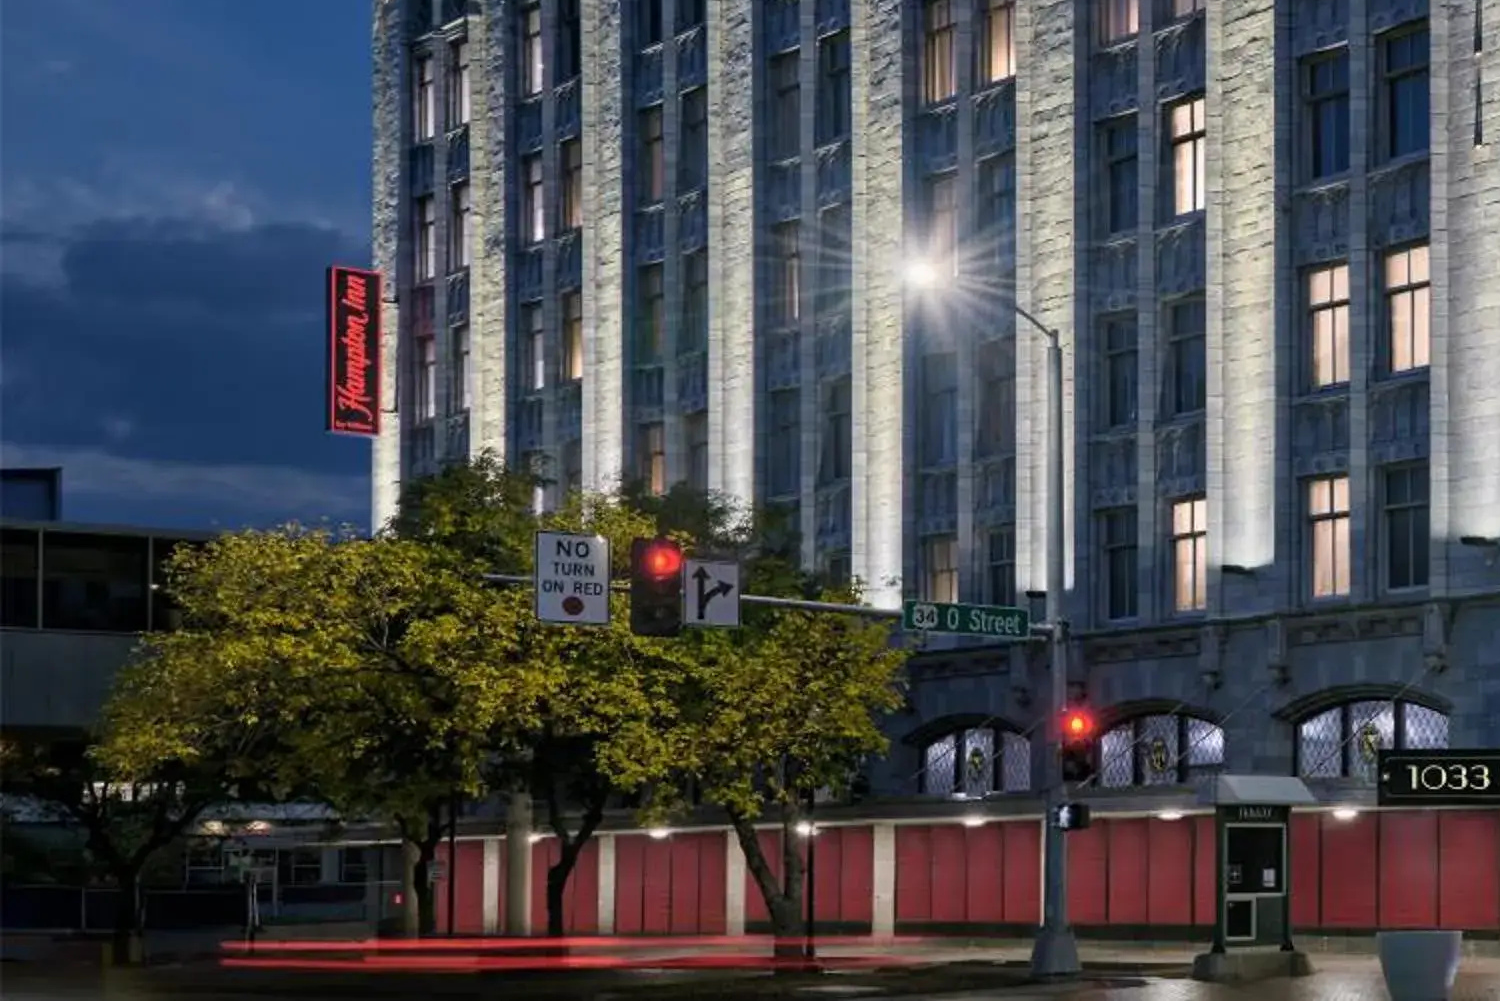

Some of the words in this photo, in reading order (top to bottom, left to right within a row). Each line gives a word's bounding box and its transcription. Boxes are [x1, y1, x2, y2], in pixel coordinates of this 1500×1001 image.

[342, 274, 366, 311] Inn
[336, 312, 372, 422] Hampton
[556, 540, 590, 558] NO
[553, 562, 595, 577] TURN
[542, 580, 564, 594] ON
[573, 582, 603, 596] RED
[915, 607, 936, 624] 34
[947, 606, 960, 630] O
[968, 608, 1020, 634] Street
[1405, 764, 1491, 791] 1033
